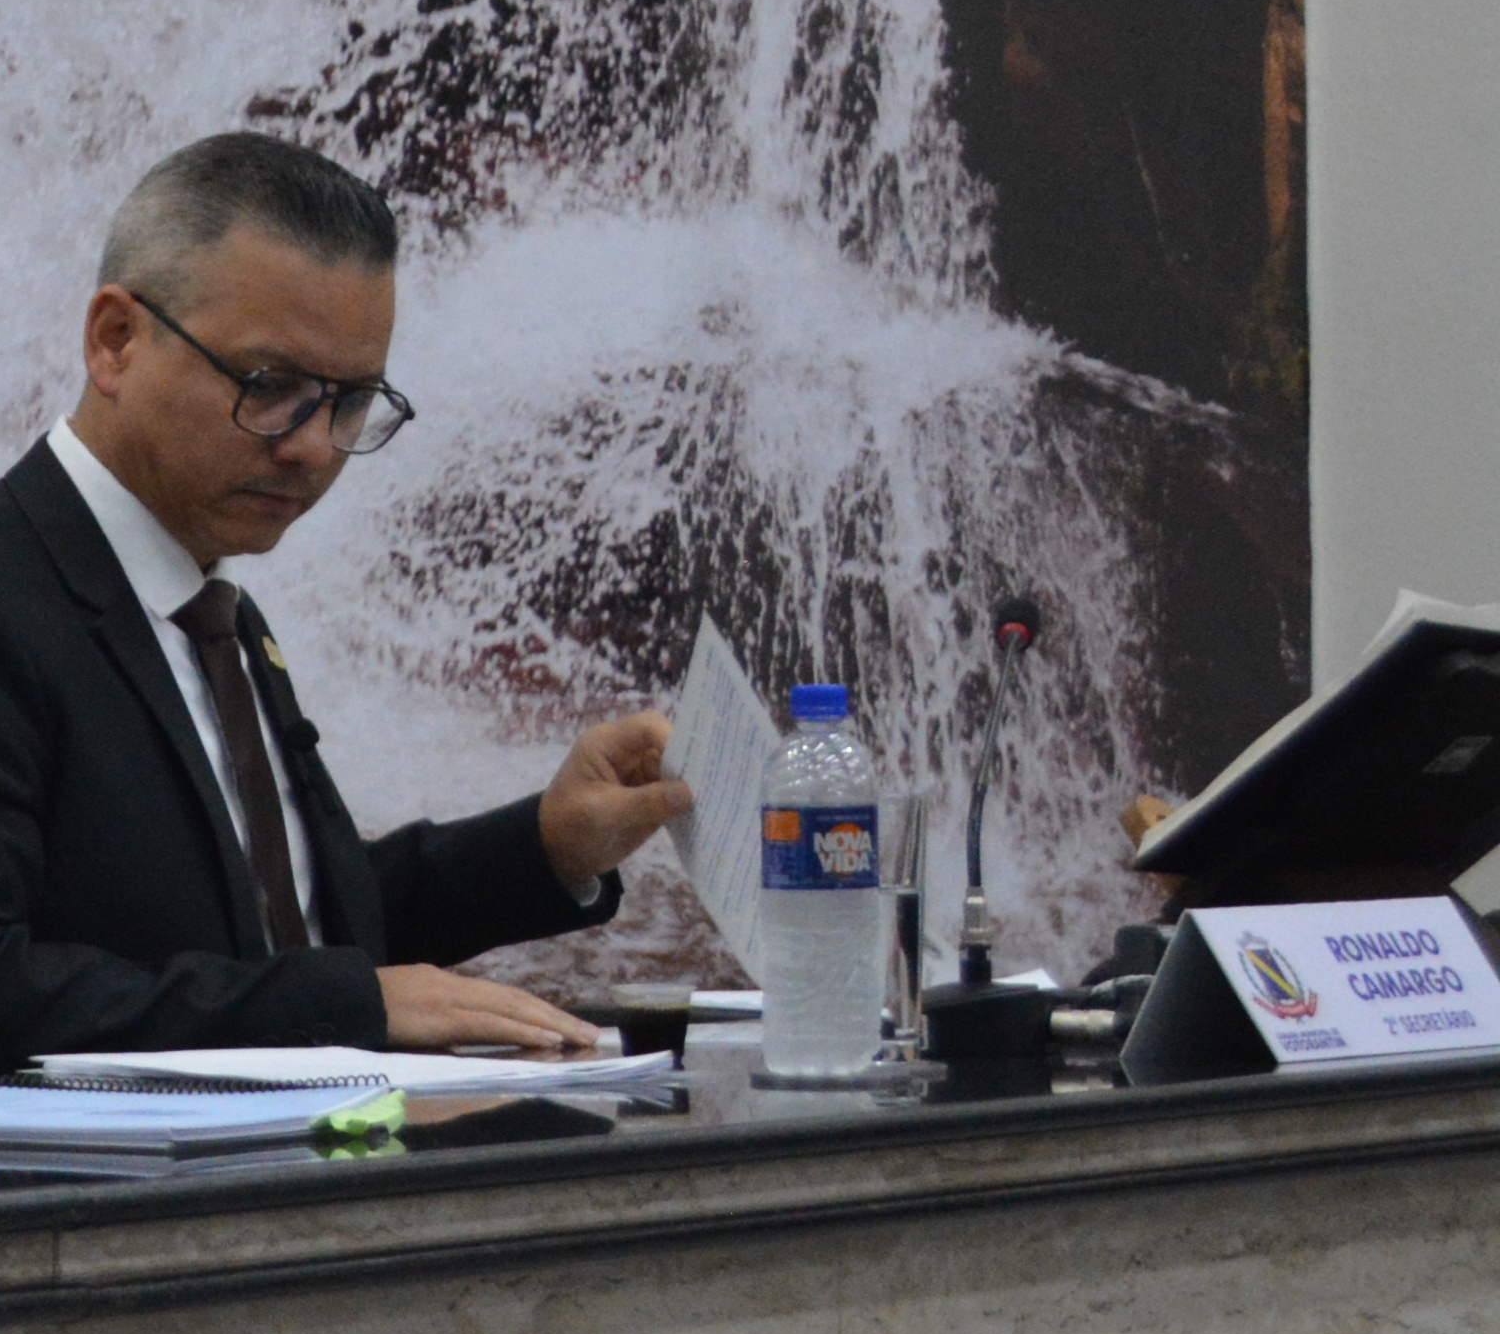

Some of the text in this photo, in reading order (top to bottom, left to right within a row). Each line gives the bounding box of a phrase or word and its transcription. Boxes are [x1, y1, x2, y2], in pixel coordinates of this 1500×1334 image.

[813, 830, 873, 852] NOVA
[816, 850, 871, 873] VIDA
[1323, 928, 1441, 964] RONALDO
[1347, 966, 1464, 1002] CAMARGO
[1400, 1008, 1477, 1034] SECRETÁRIO
